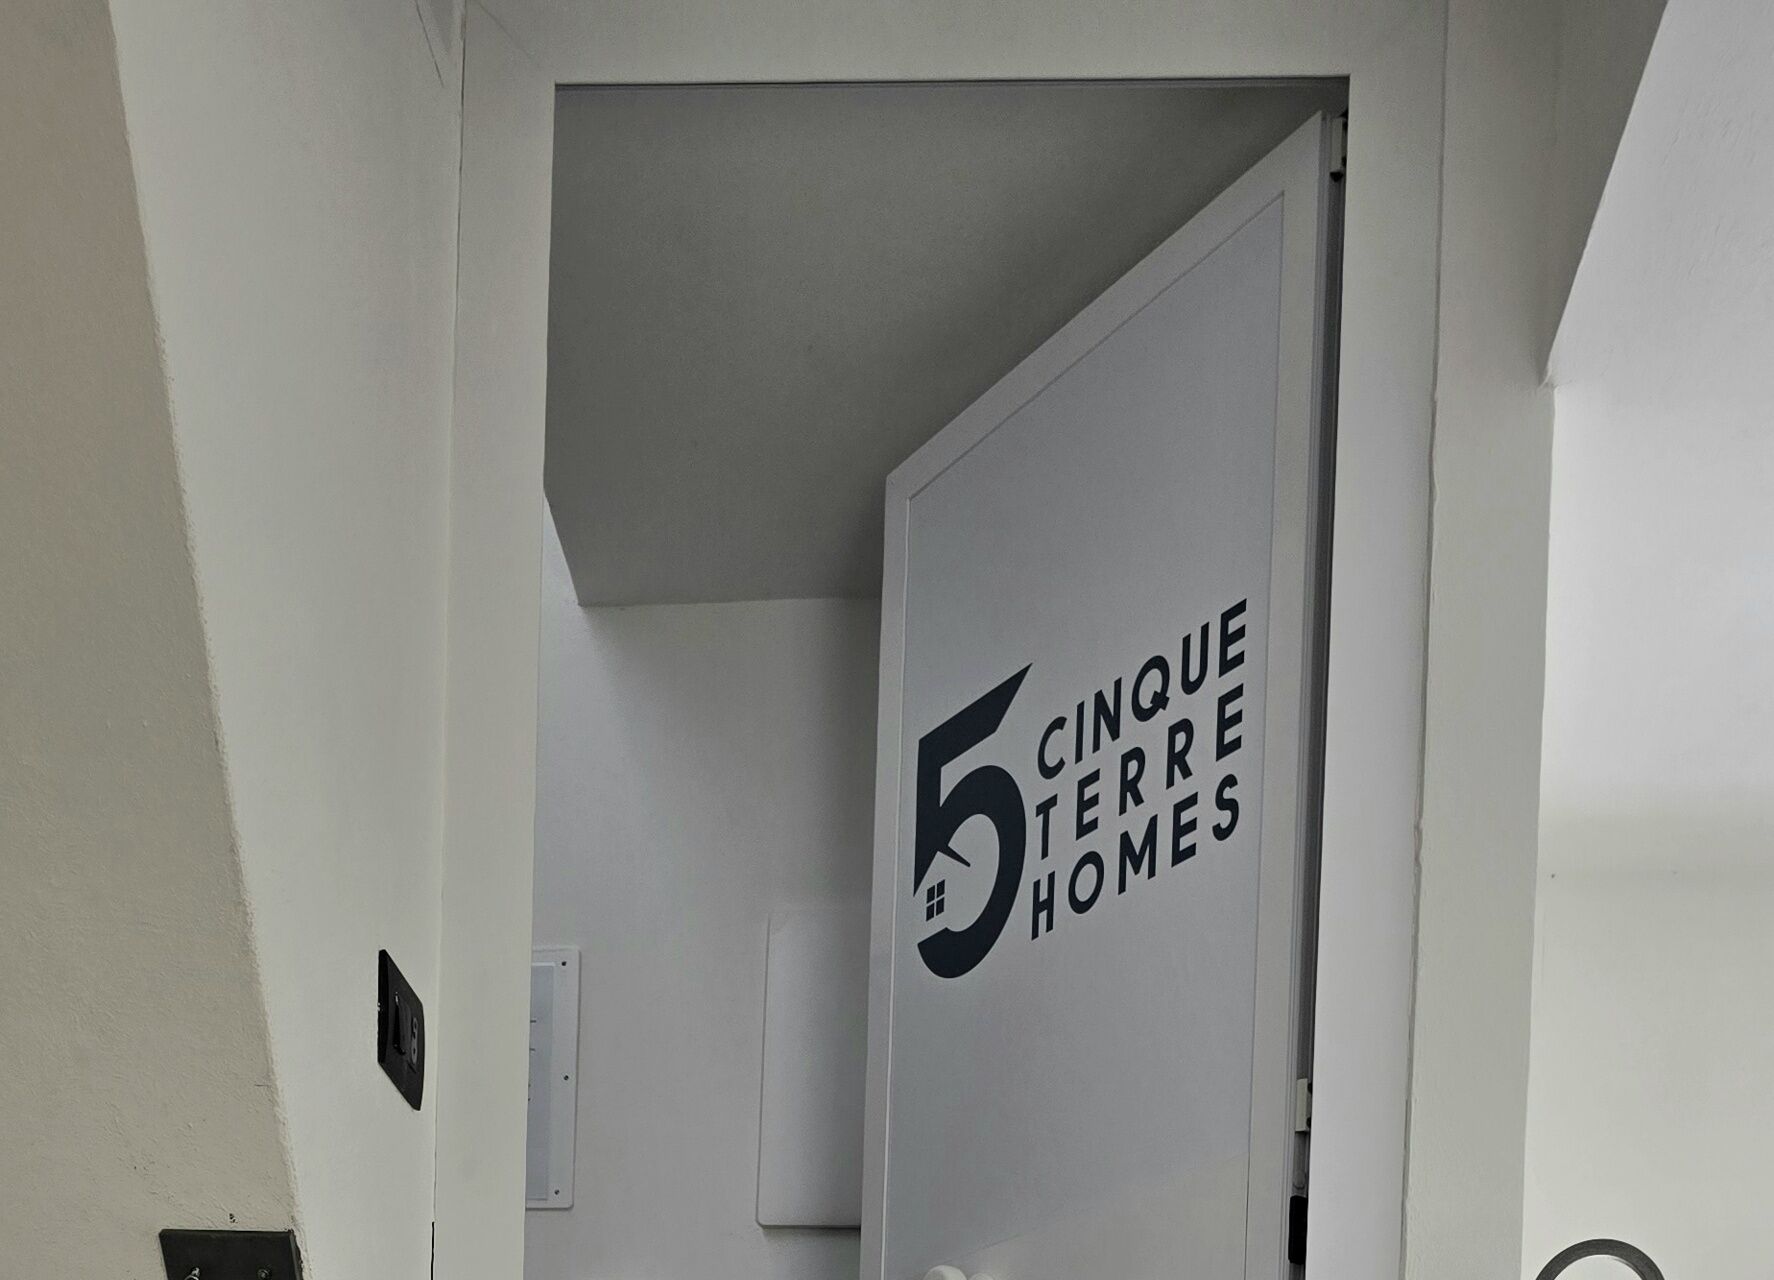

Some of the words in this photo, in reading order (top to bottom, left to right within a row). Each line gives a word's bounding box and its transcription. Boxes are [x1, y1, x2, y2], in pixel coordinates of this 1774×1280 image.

[1035, 683, 1243, 860] TERRE
[1037, 598, 1247, 780] CINQUE
[912, 662, 1033, 979] 5
[1031, 774, 1240, 941] HOMES
